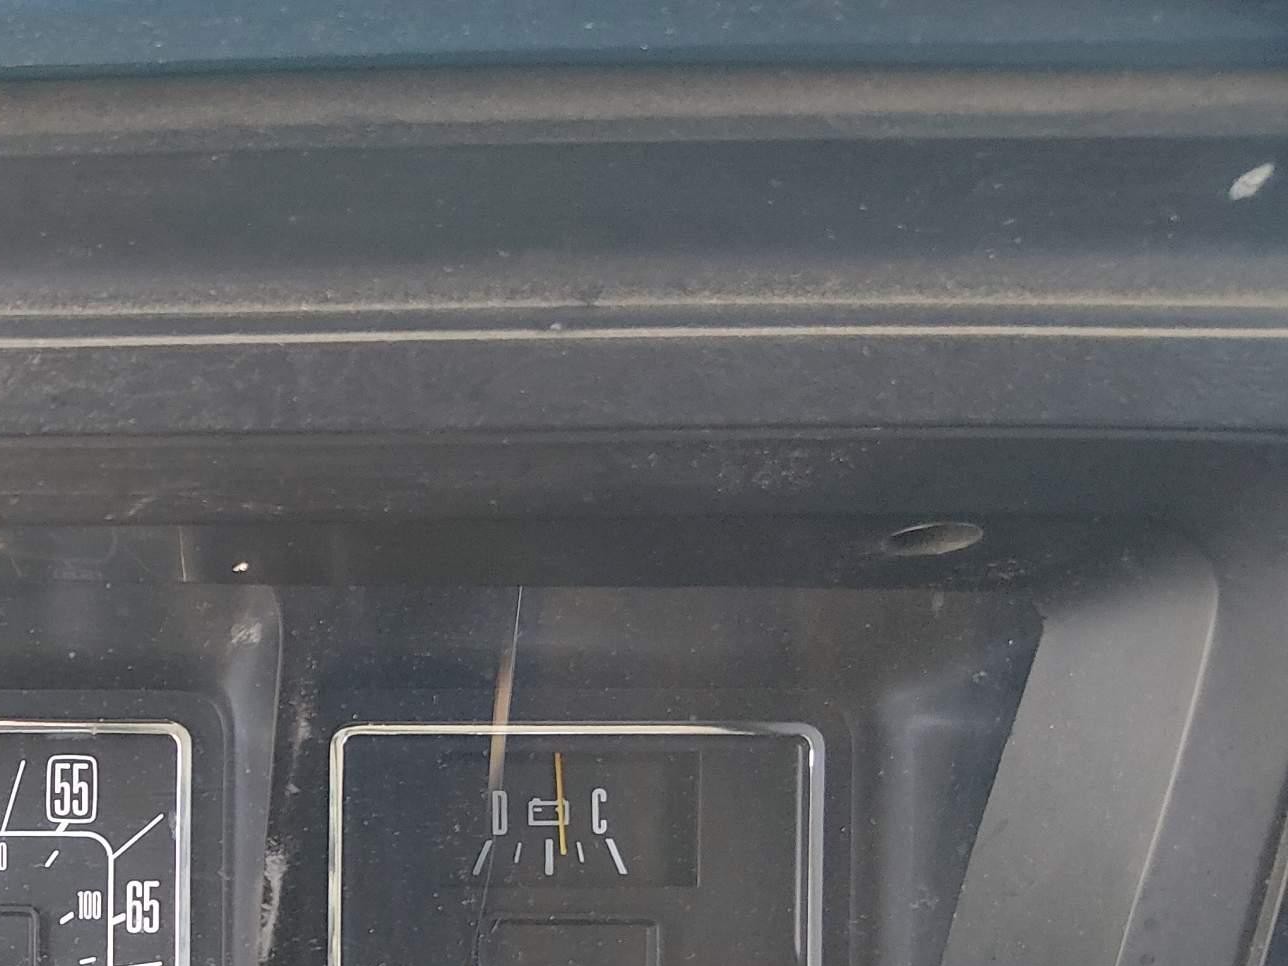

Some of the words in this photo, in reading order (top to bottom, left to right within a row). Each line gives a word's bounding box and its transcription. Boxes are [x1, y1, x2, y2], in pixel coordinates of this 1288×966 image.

[54, 763, 89, 816] 55
[492, 790, 508, 835] D
[591, 788, 607, 834] C
[77, 890, 102, 919] 100
[126, 880, 160, 933] 65
